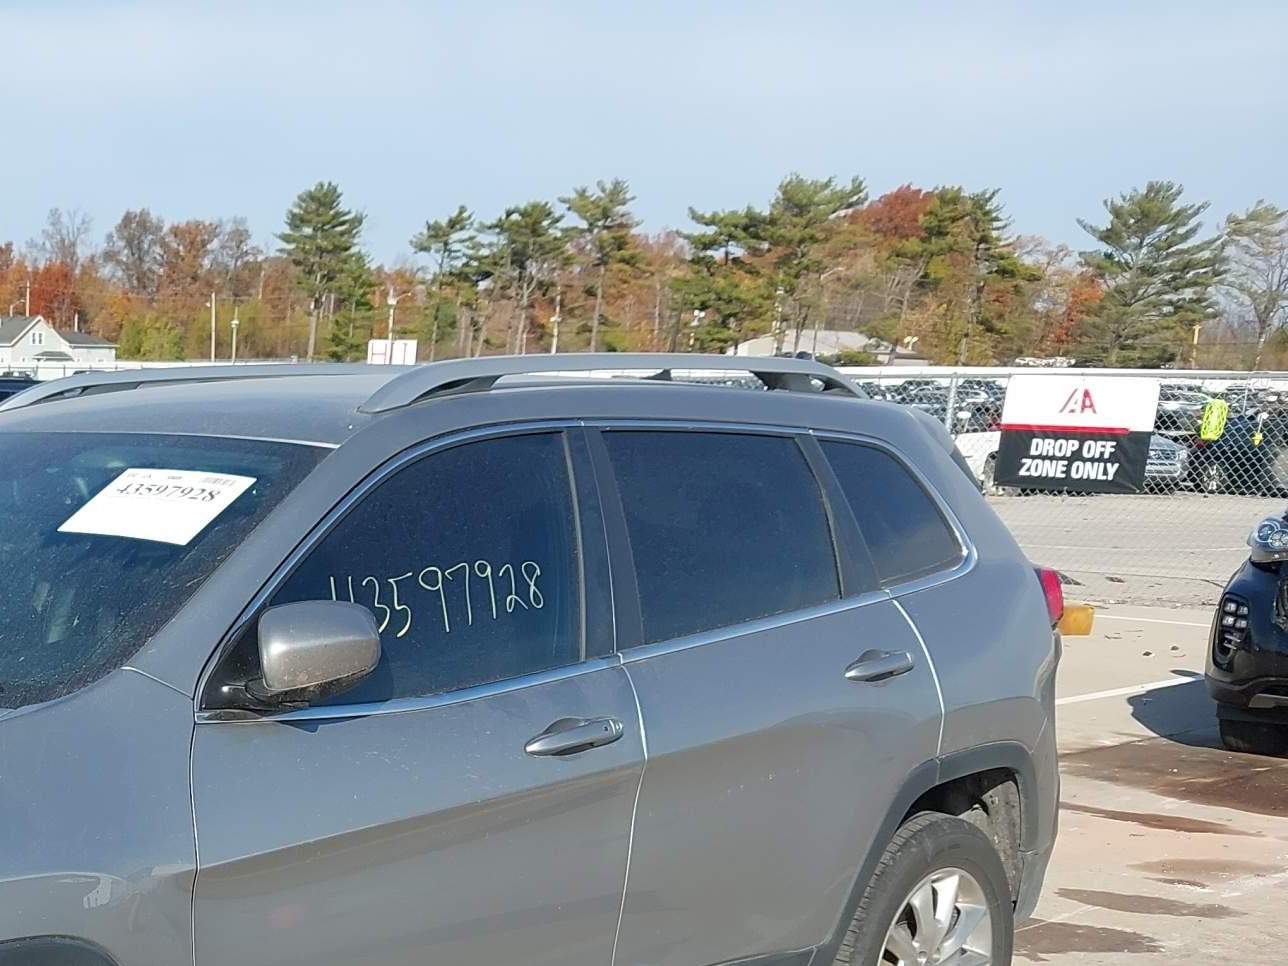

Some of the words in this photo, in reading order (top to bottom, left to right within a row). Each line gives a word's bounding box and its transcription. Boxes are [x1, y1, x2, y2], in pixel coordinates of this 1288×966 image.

[1030, 438, 1080, 457] DROP
[1082, 441, 1117, 459] OFF
[1019, 458, 1068, 478] ZONE
[1070, 461, 1119, 481] ONLY
[116, 483, 221, 502] 43597928
